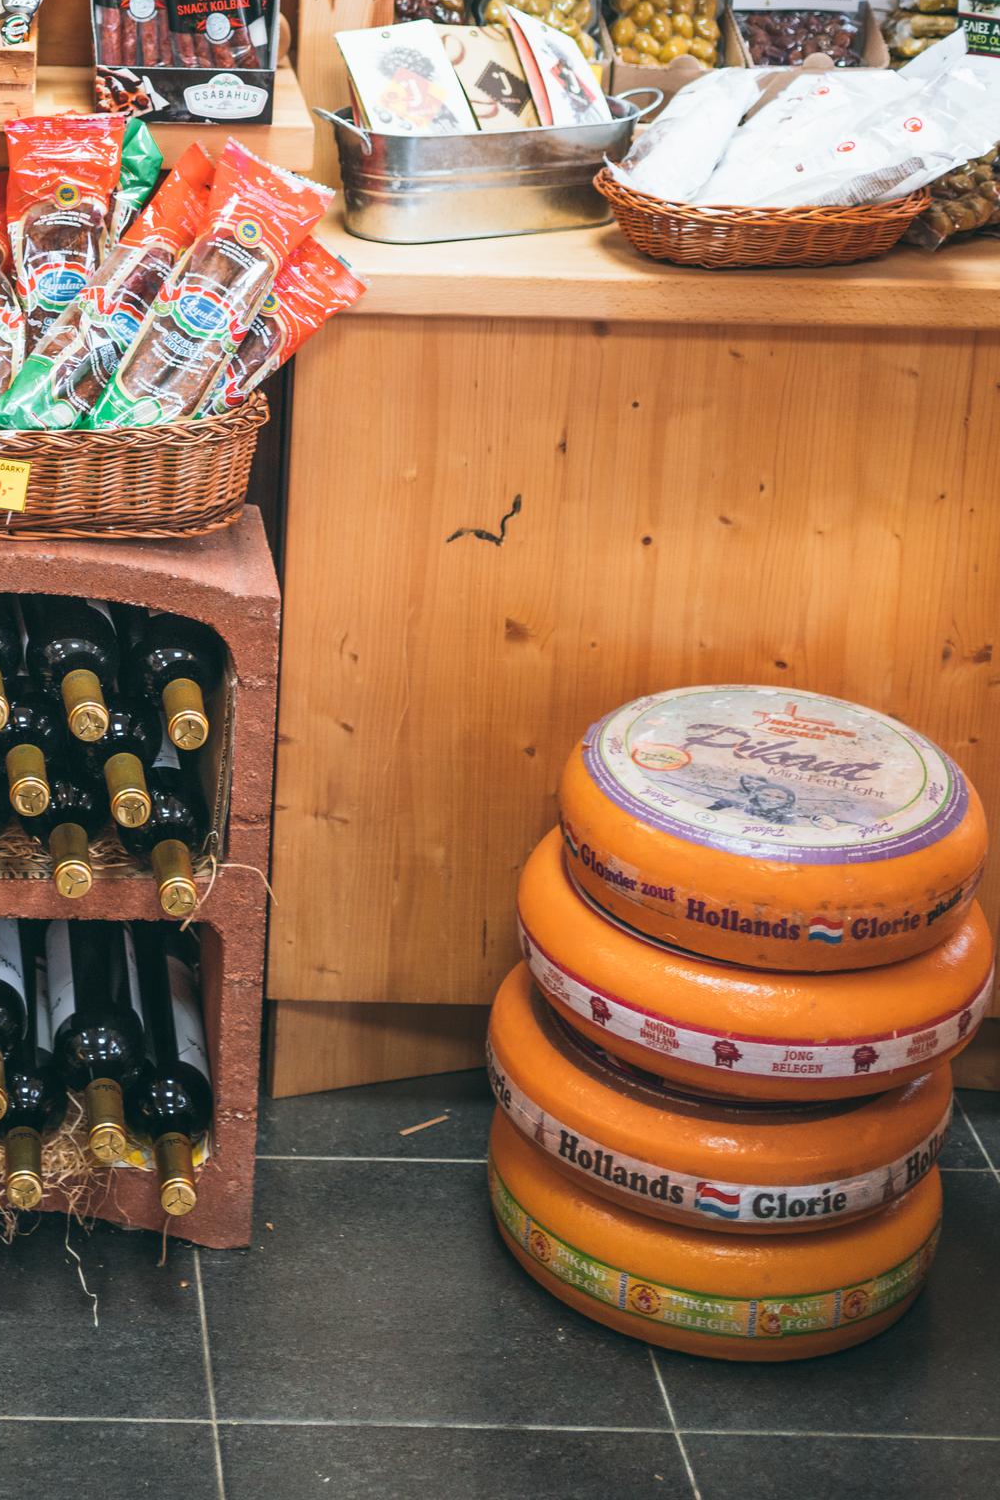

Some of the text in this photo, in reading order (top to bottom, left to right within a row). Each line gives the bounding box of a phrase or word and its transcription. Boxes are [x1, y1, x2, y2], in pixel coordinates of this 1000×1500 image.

[177, 2, 209, 16] SNACK
[767, 726, 826, 741] GLORIE
[769, 719, 857, 738] HOLLANDS
[768, 765, 803, 781] Mini
[641, 880, 675, 902] zout
[685, 899, 800, 941] Hollands
[851, 910, 919, 940] Glorie
[644, 1018, 676, 1038] NOORD
[639, 1028, 680, 1049] HOLLAND
[783, 1049, 814, 1062] JONG
[771, 1063, 824, 1075] BELEGEN
[558, 1130, 847, 1220] Hollands Glorie
[556, 1246, 609, 1283] PIKANT
[551, 1260, 614, 1301] BELEGEN
[671, 1295, 737, 1317] PIKANT
[663, 1311, 743, 1334] BELEGEN
